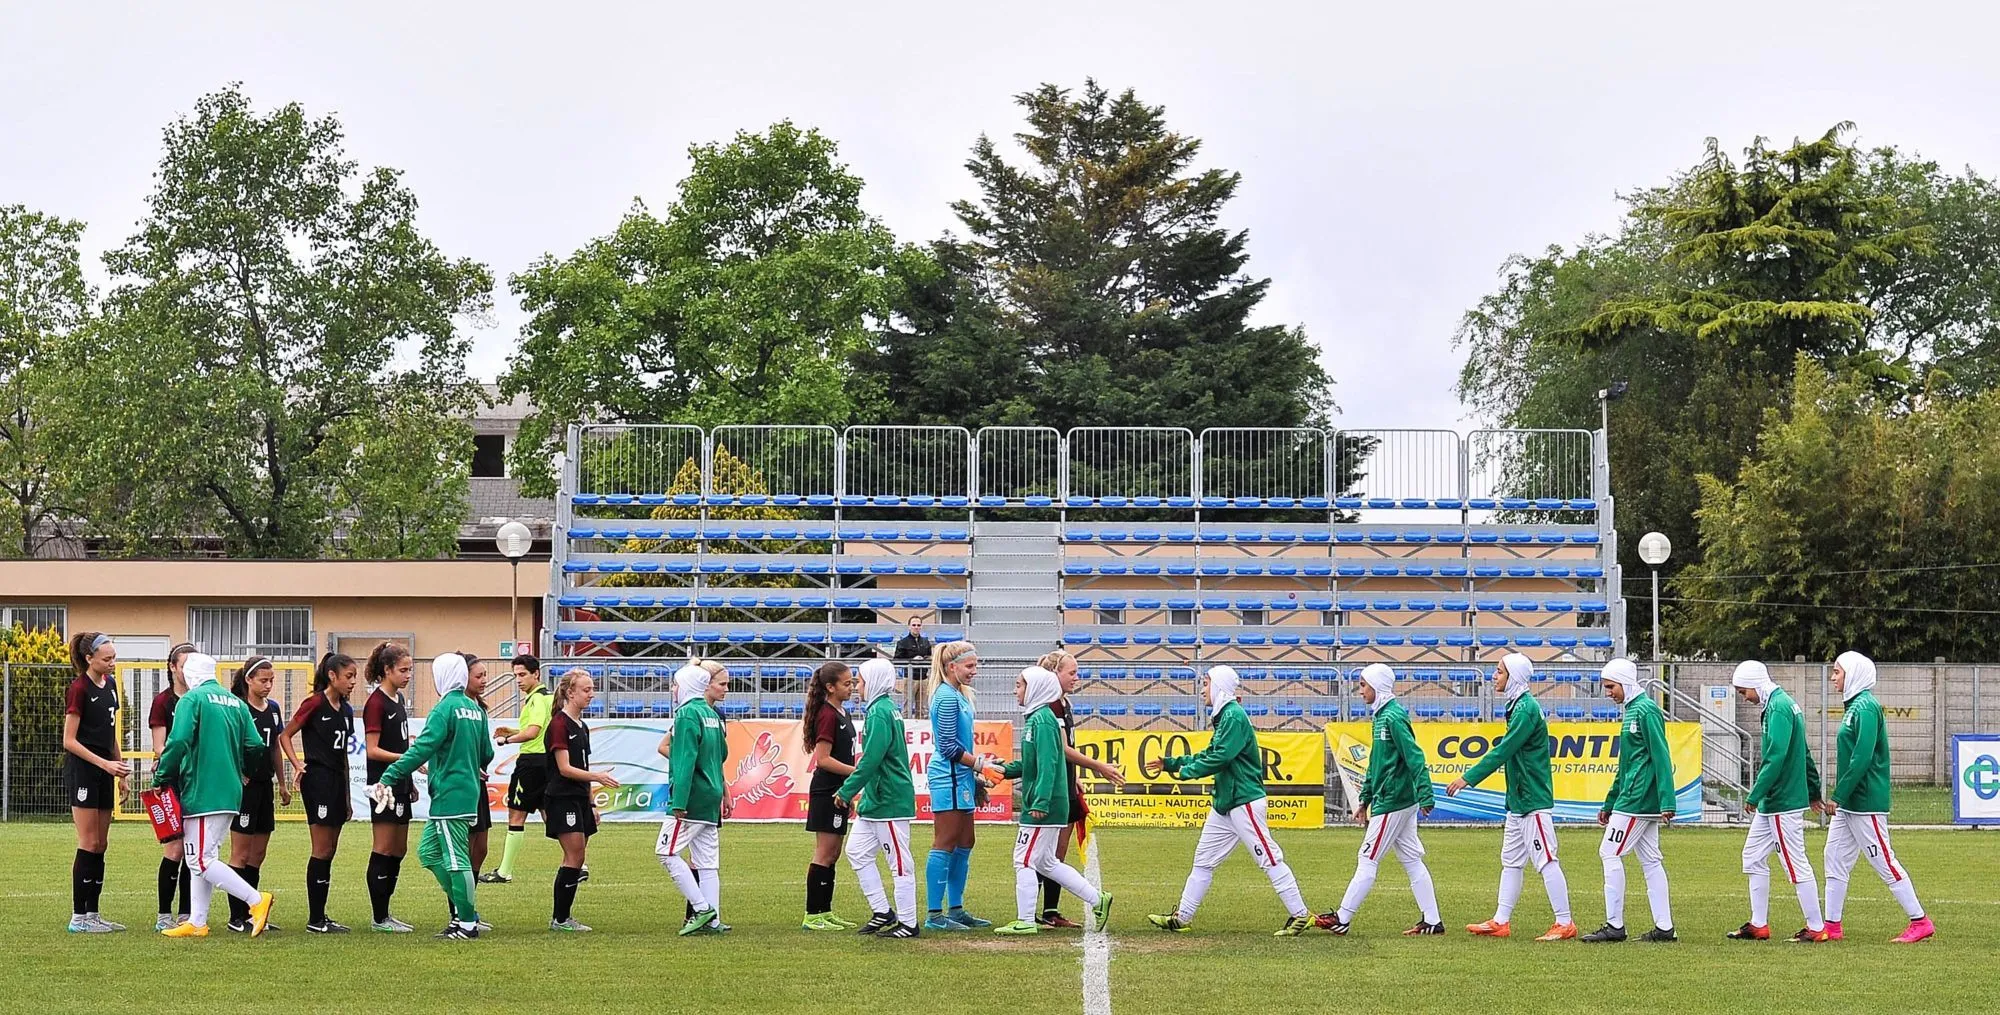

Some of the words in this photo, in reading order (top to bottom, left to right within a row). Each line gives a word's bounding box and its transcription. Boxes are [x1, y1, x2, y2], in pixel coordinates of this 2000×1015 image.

[108, 707, 116, 726] 3
[263, 727, 271, 747] 7
[333, 730, 346, 750] 21
[1112, 798, 1156, 807] METALLI
[1165, 799, 1213, 808] NAUTICA
[1100, 810, 1143, 819] Legionari
[1176, 811, 1190, 819] Via
[1291, 812, 1297, 820] 7
[661, 833, 668, 845] 3
[1017, 830, 1030, 845] 13
[1607, 827, 1624, 843] 10
[185, 842, 195, 856] 11
[883, 842, 891, 854] 9
[1254, 844, 1263, 856] 6
[1533, 839, 1542, 851] 8
[1867, 844, 1878, 858] 17
